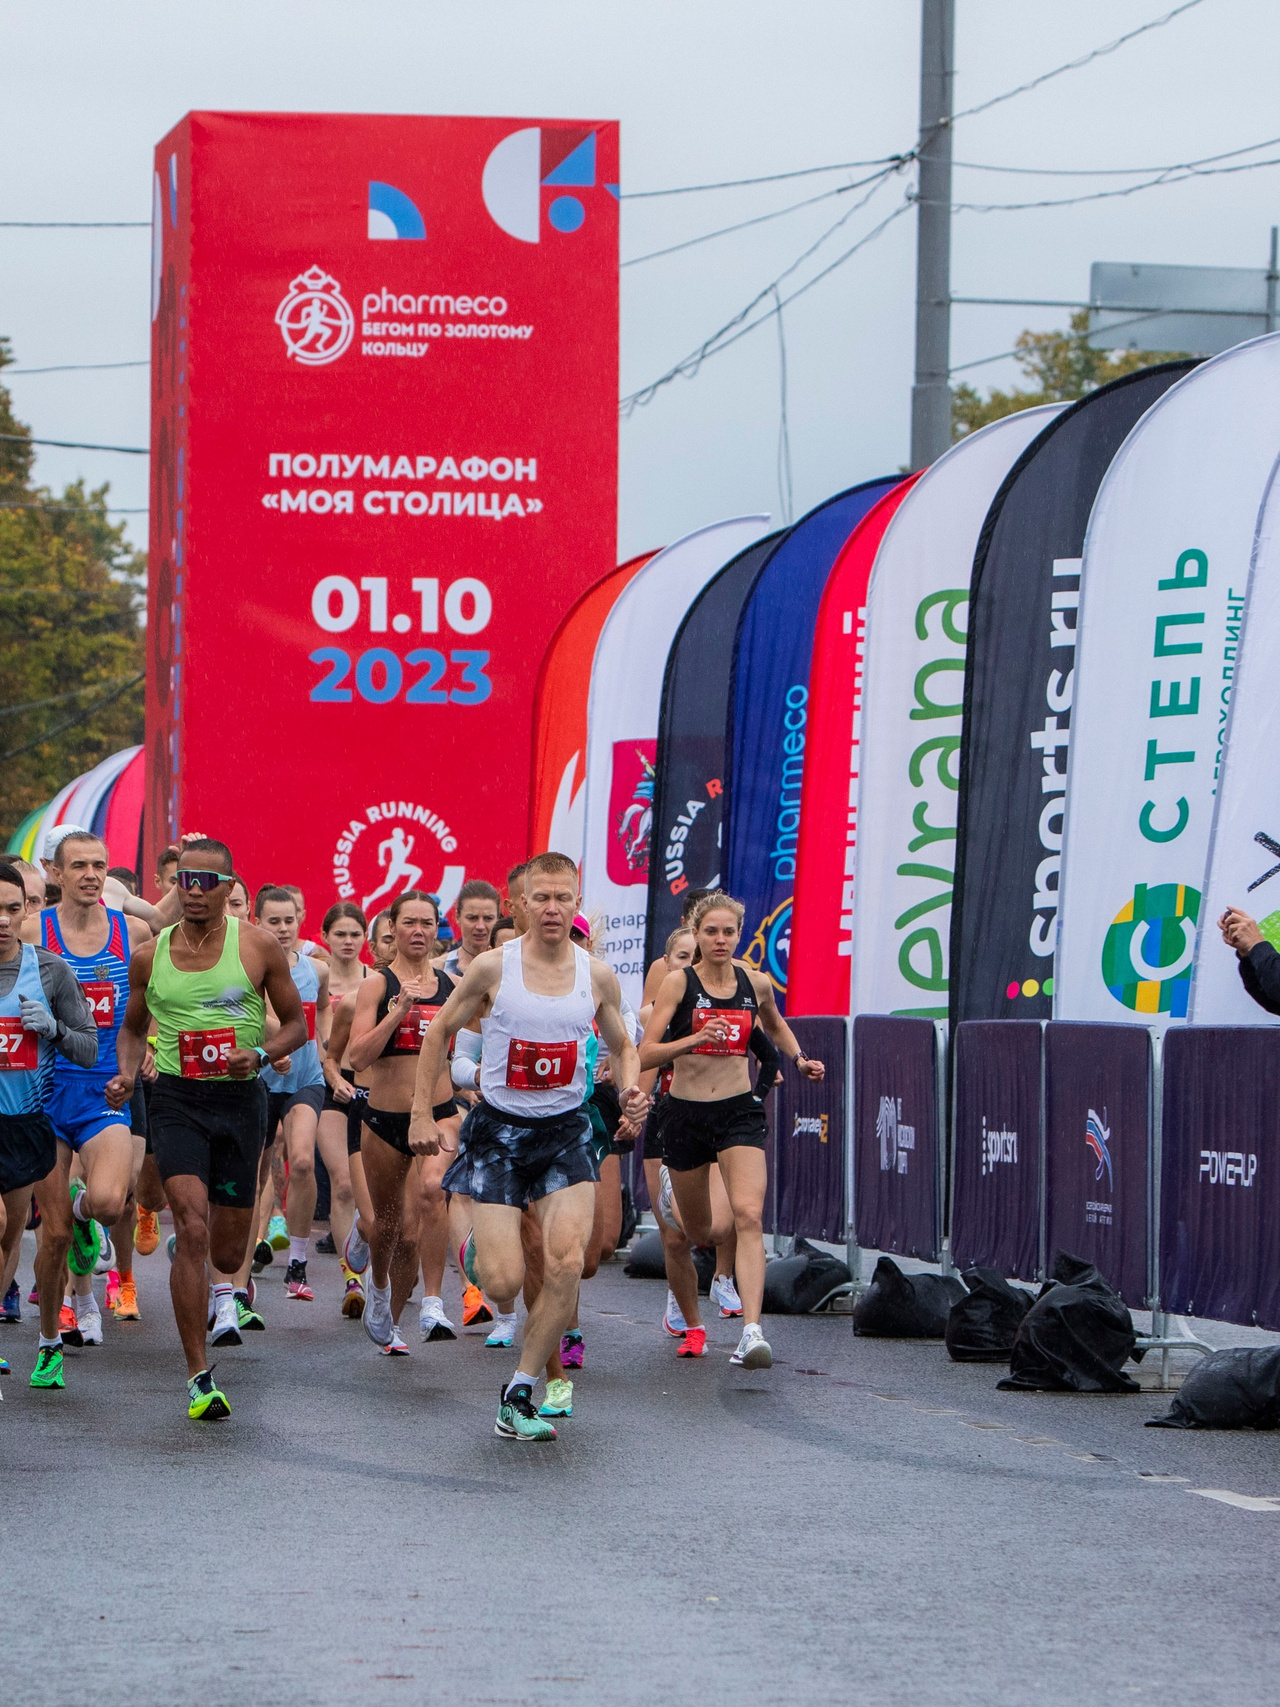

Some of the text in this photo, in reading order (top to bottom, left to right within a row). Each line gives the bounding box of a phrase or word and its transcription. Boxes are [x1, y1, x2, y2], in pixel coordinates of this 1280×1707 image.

[362, 287, 507, 318] pharmeco
[362, 321, 533, 340] БЕГОМ ПО ЗОЛОТОМУ
[362, 341, 428, 358] КОЛЬЦУ
[268, 453, 537, 482] ПОЛУМАРАФОН
[261, 489, 543, 521] «МОЯ СТОЛИЦА»
[310, 575, 492, 635] 01.10
[308, 647, 492, 705] 2023
[1137, 546, 1208, 844] СТЕПЬ
[769, 684, 809, 881] pharmeco
[333, 800, 458, 899] RUSSIA RUNNING
[665, 800, 706, 896] RUSSIA
[202, 1042, 233, 1063] 05
[535, 1057, 561, 1076] 01
[1199, 1149, 1257, 1187] POWERUP
